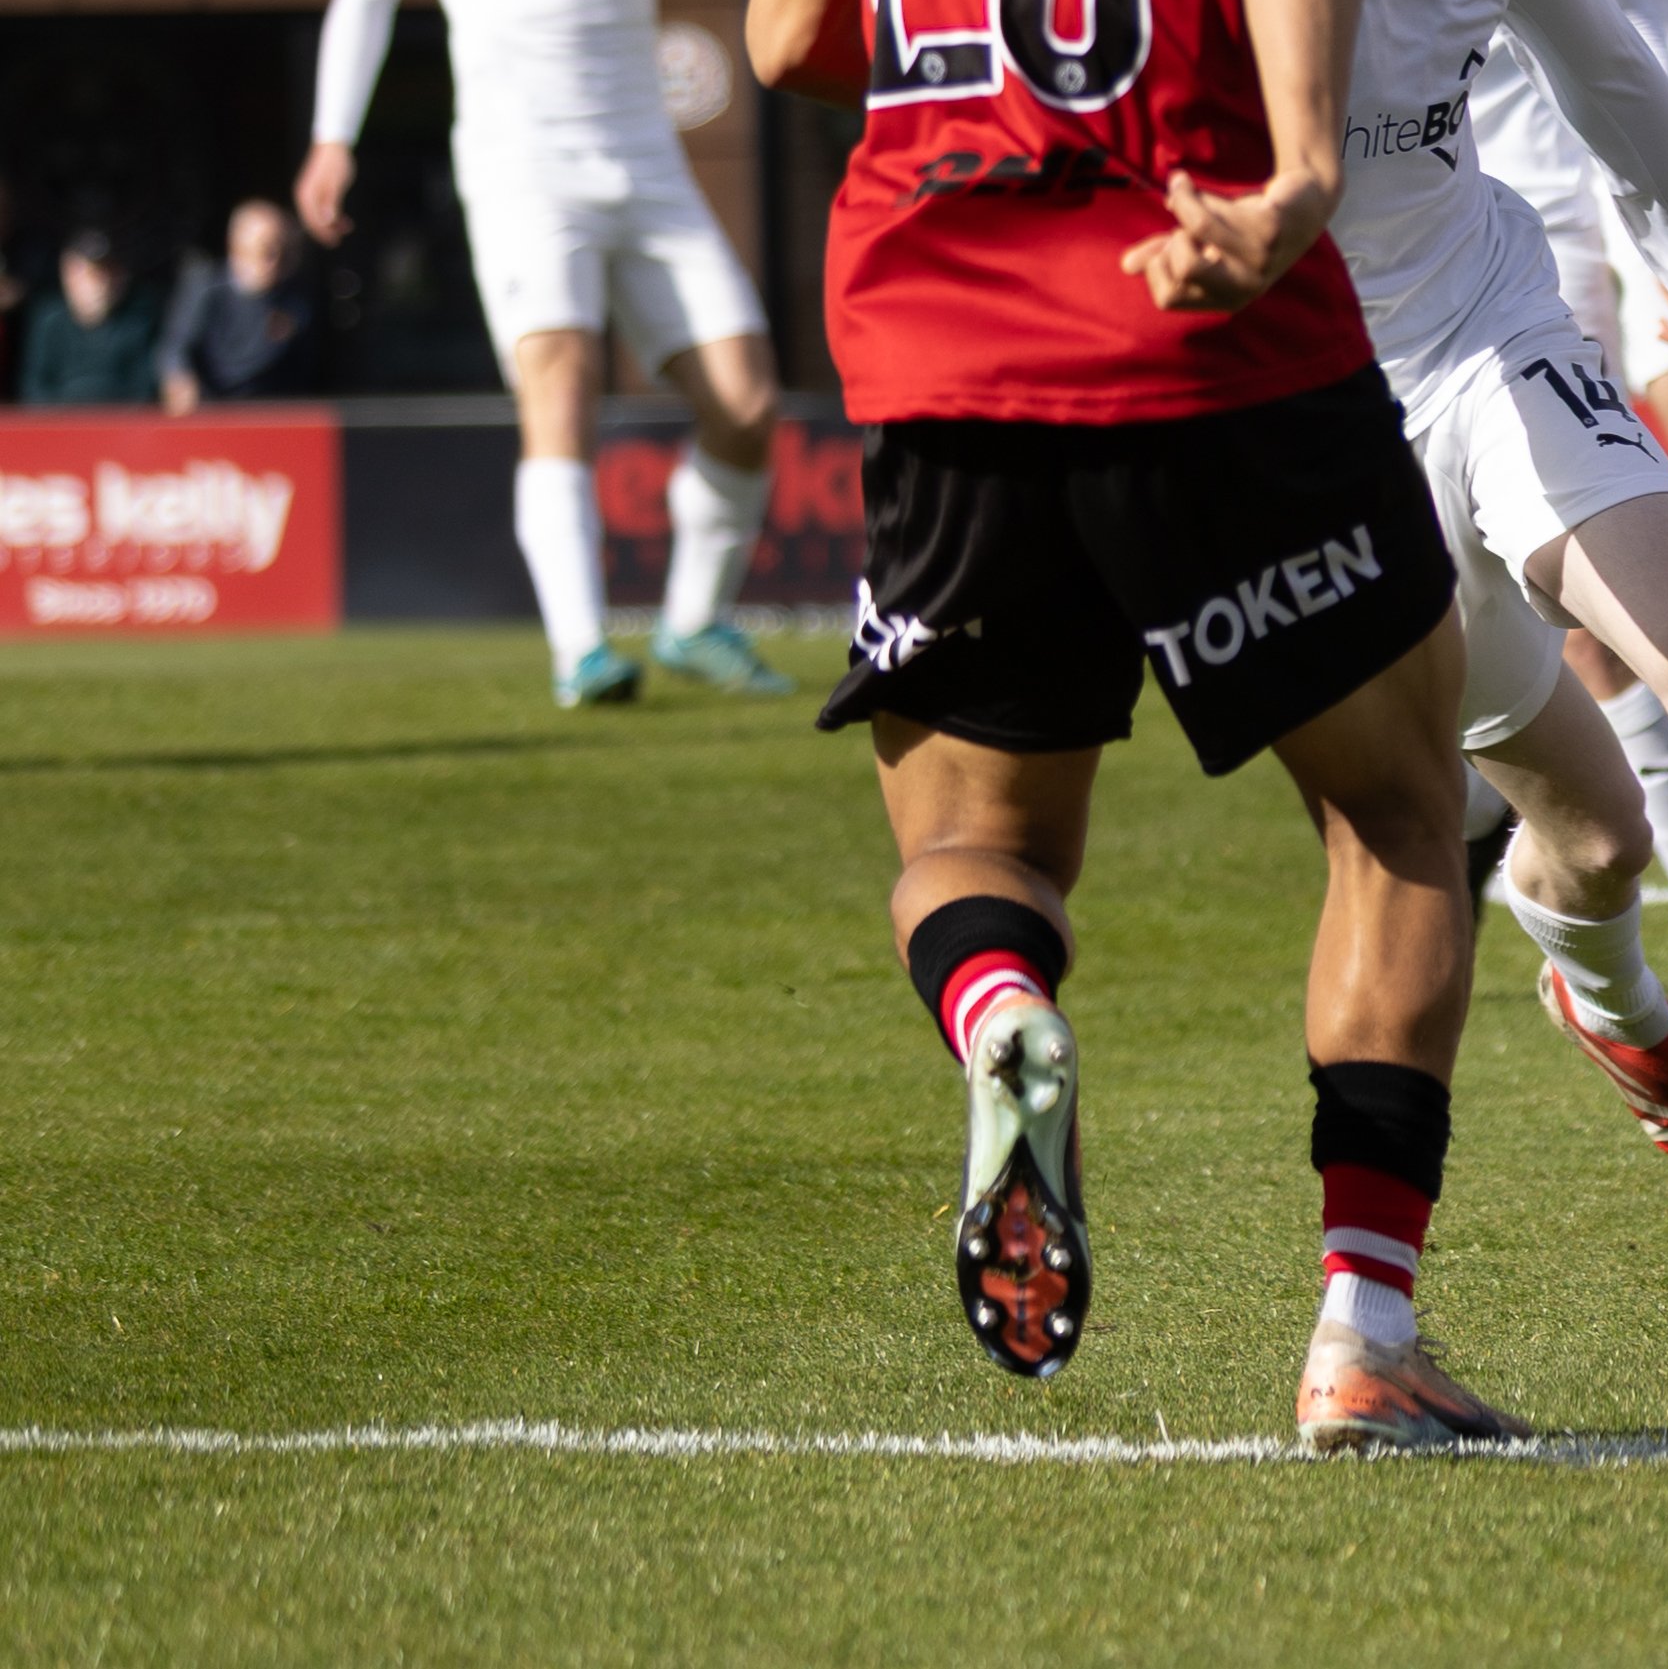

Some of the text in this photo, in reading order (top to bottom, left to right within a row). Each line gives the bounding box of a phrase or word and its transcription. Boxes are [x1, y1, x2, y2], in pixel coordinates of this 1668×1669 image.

[1342, 90, 1469, 160] hiteBO
[1521, 358, 1638, 429] 14
[1144, 524, 1383, 687] TOKEN
